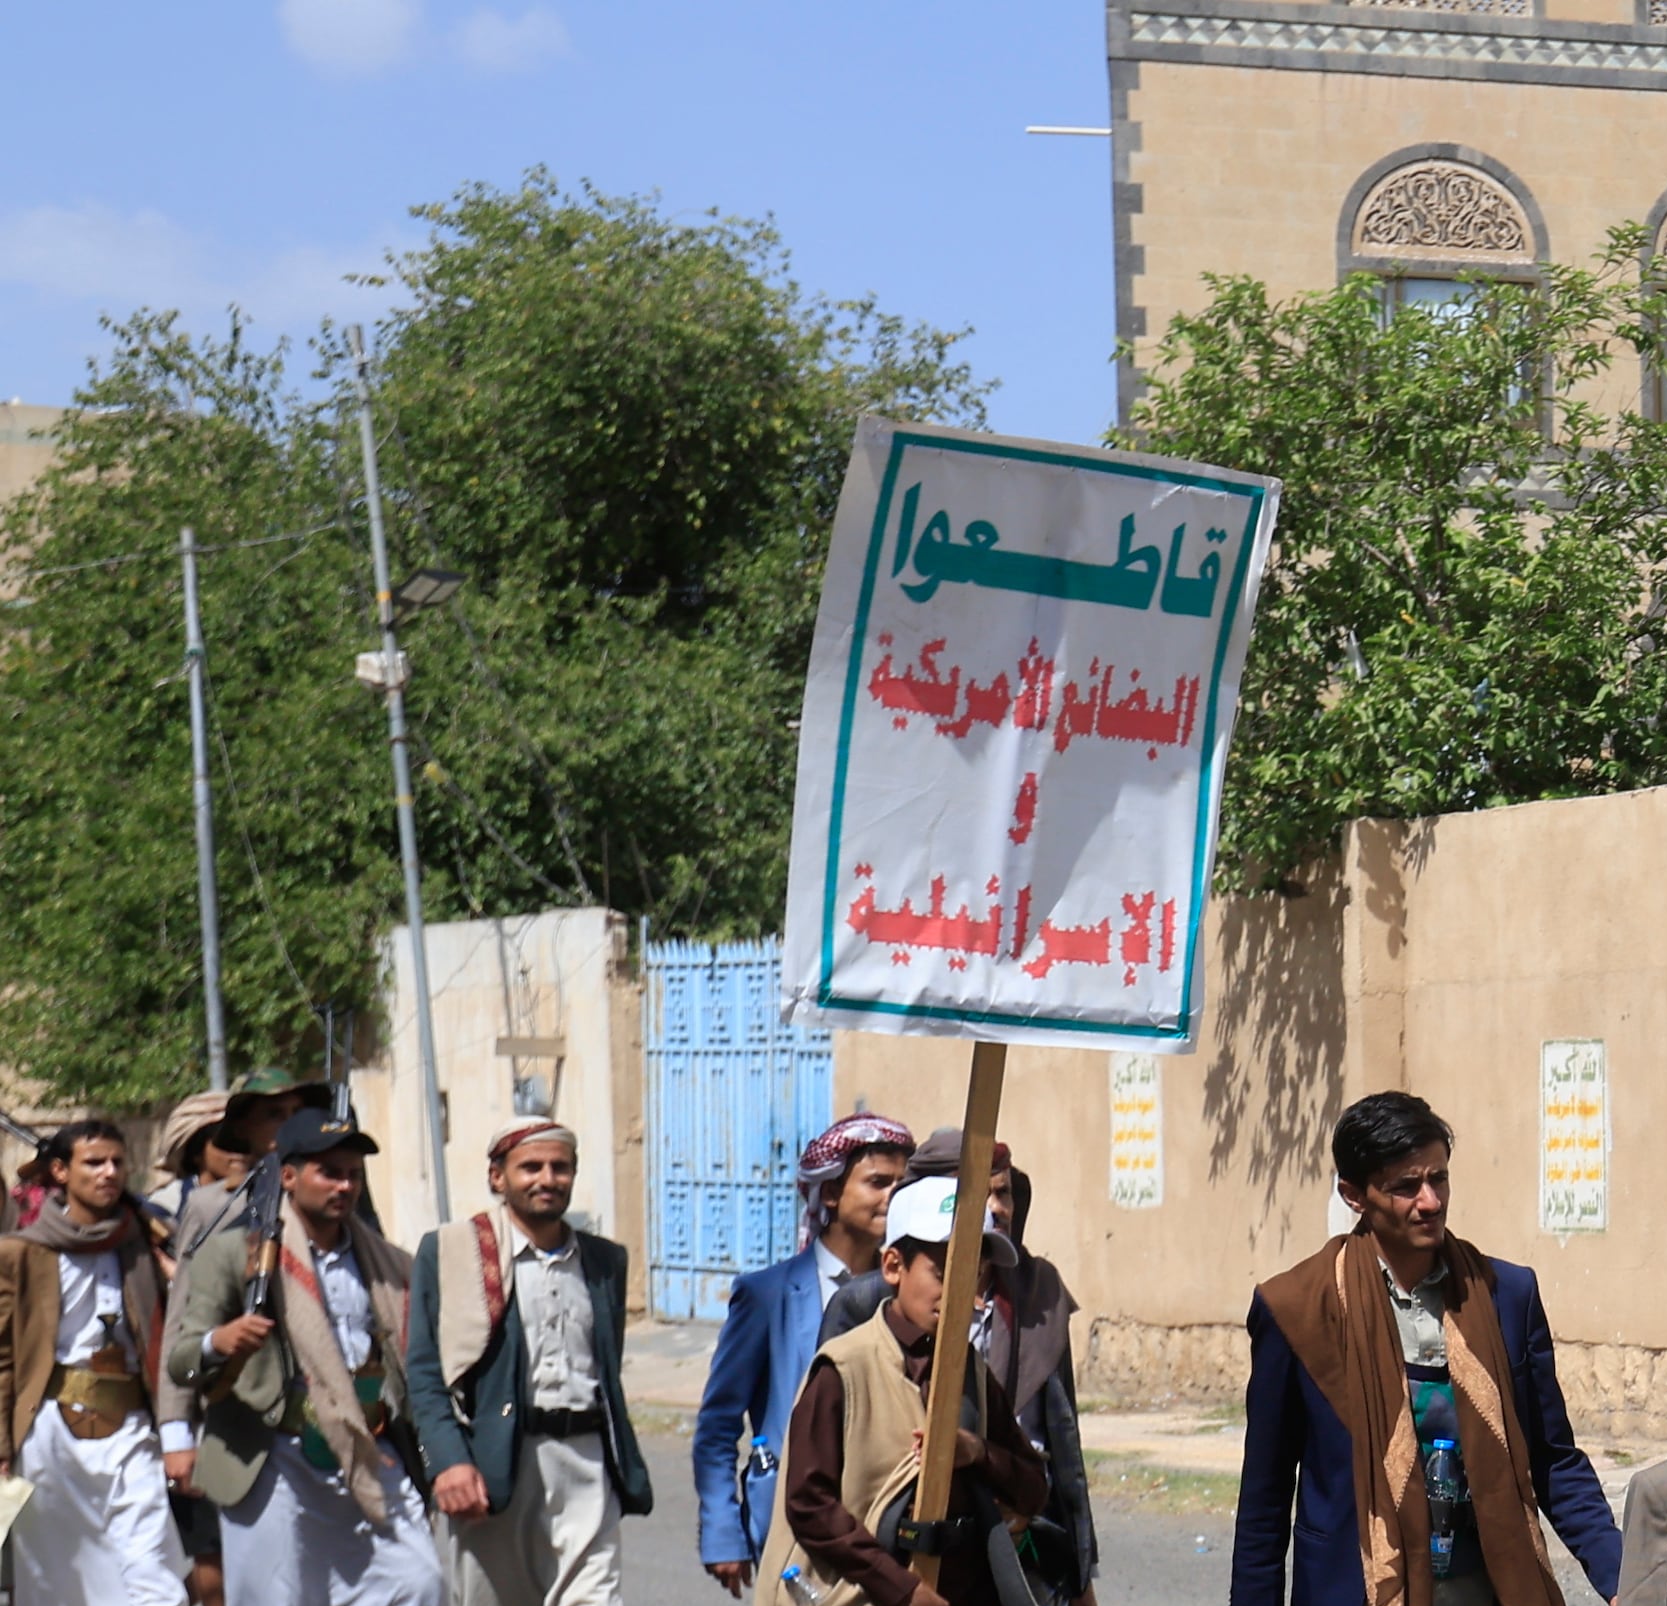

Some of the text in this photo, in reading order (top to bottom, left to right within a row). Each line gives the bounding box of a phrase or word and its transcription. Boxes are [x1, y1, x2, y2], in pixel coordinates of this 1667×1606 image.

[890, 480, 1227, 618] قاطعوا
[867, 631, 1201, 762] البضائع الأمريكية
[1007, 771, 1039, 846] و
[845, 862, 1177, 987] الإسرائيلية
